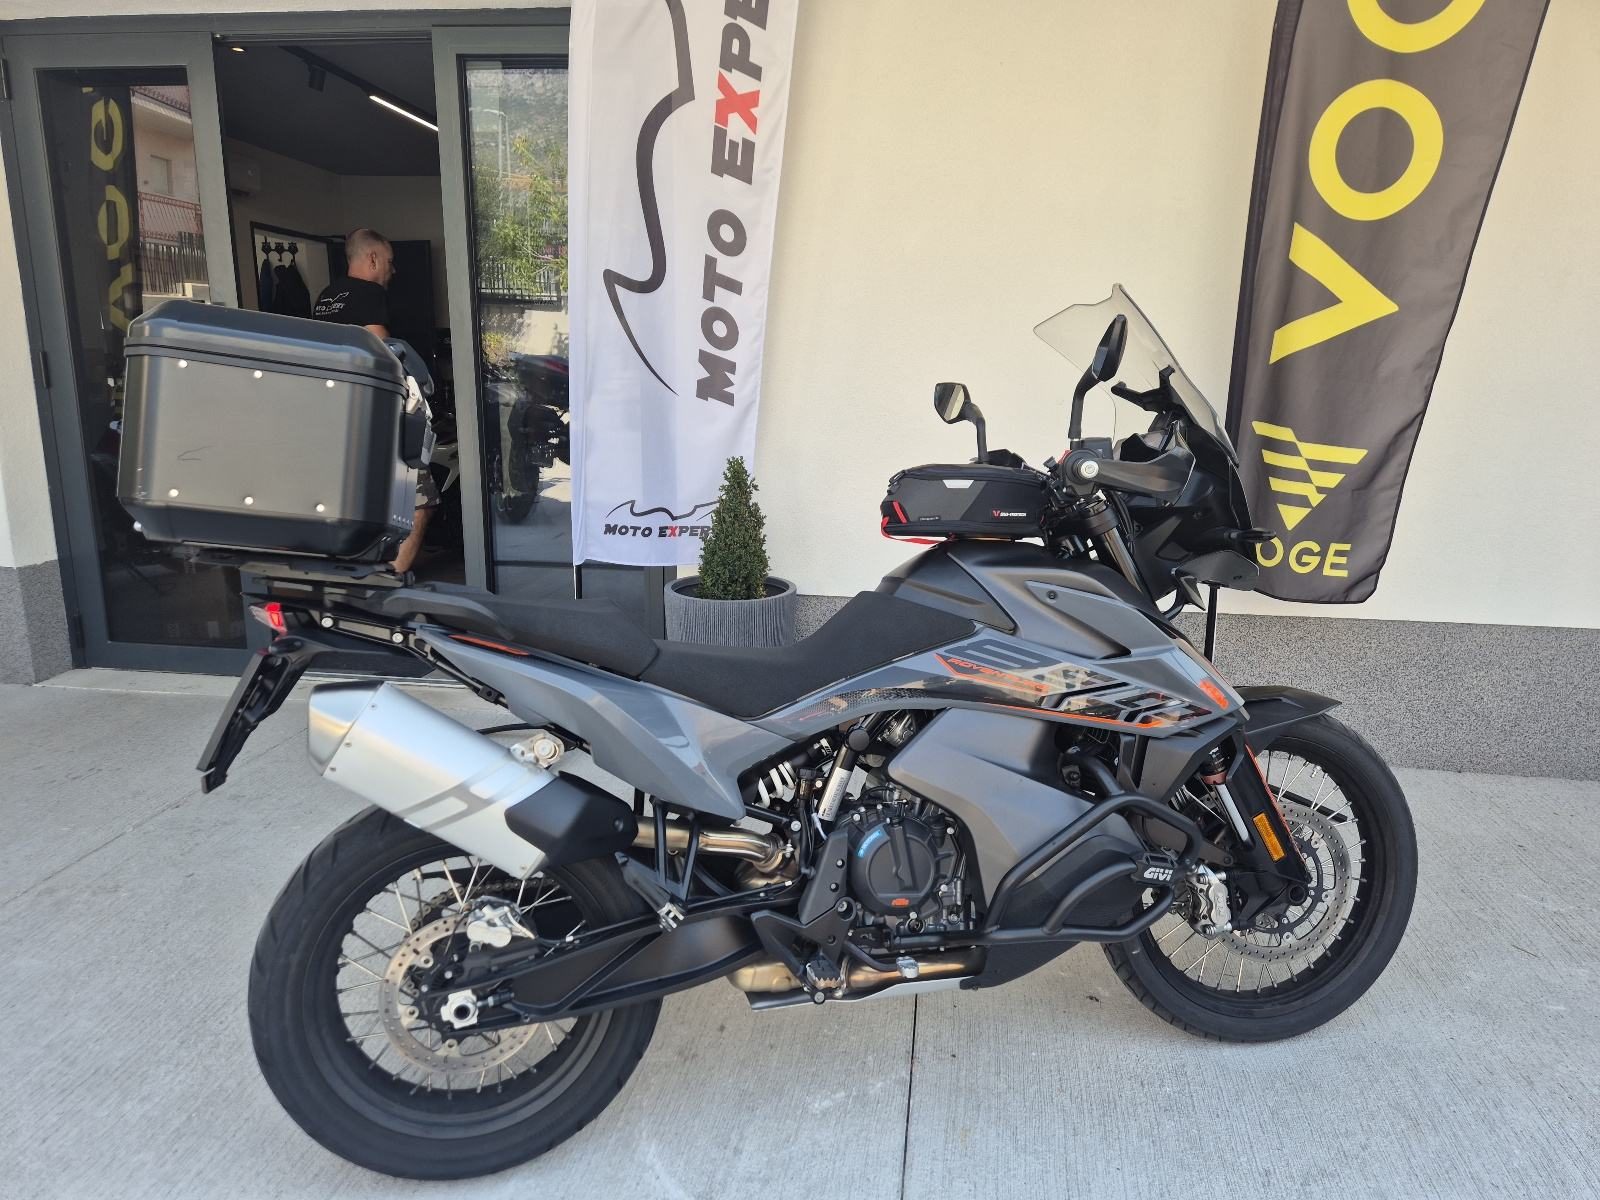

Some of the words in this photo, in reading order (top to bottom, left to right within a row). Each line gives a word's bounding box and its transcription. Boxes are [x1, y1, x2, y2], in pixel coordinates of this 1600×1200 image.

[695, 208, 747, 407] MOTO
[603, 523, 653, 538] MOTO
[657, 525, 713, 538] EXPER
[1256, 537, 1352, 577] OGE
[1143, 866, 1174, 882] GIVI
